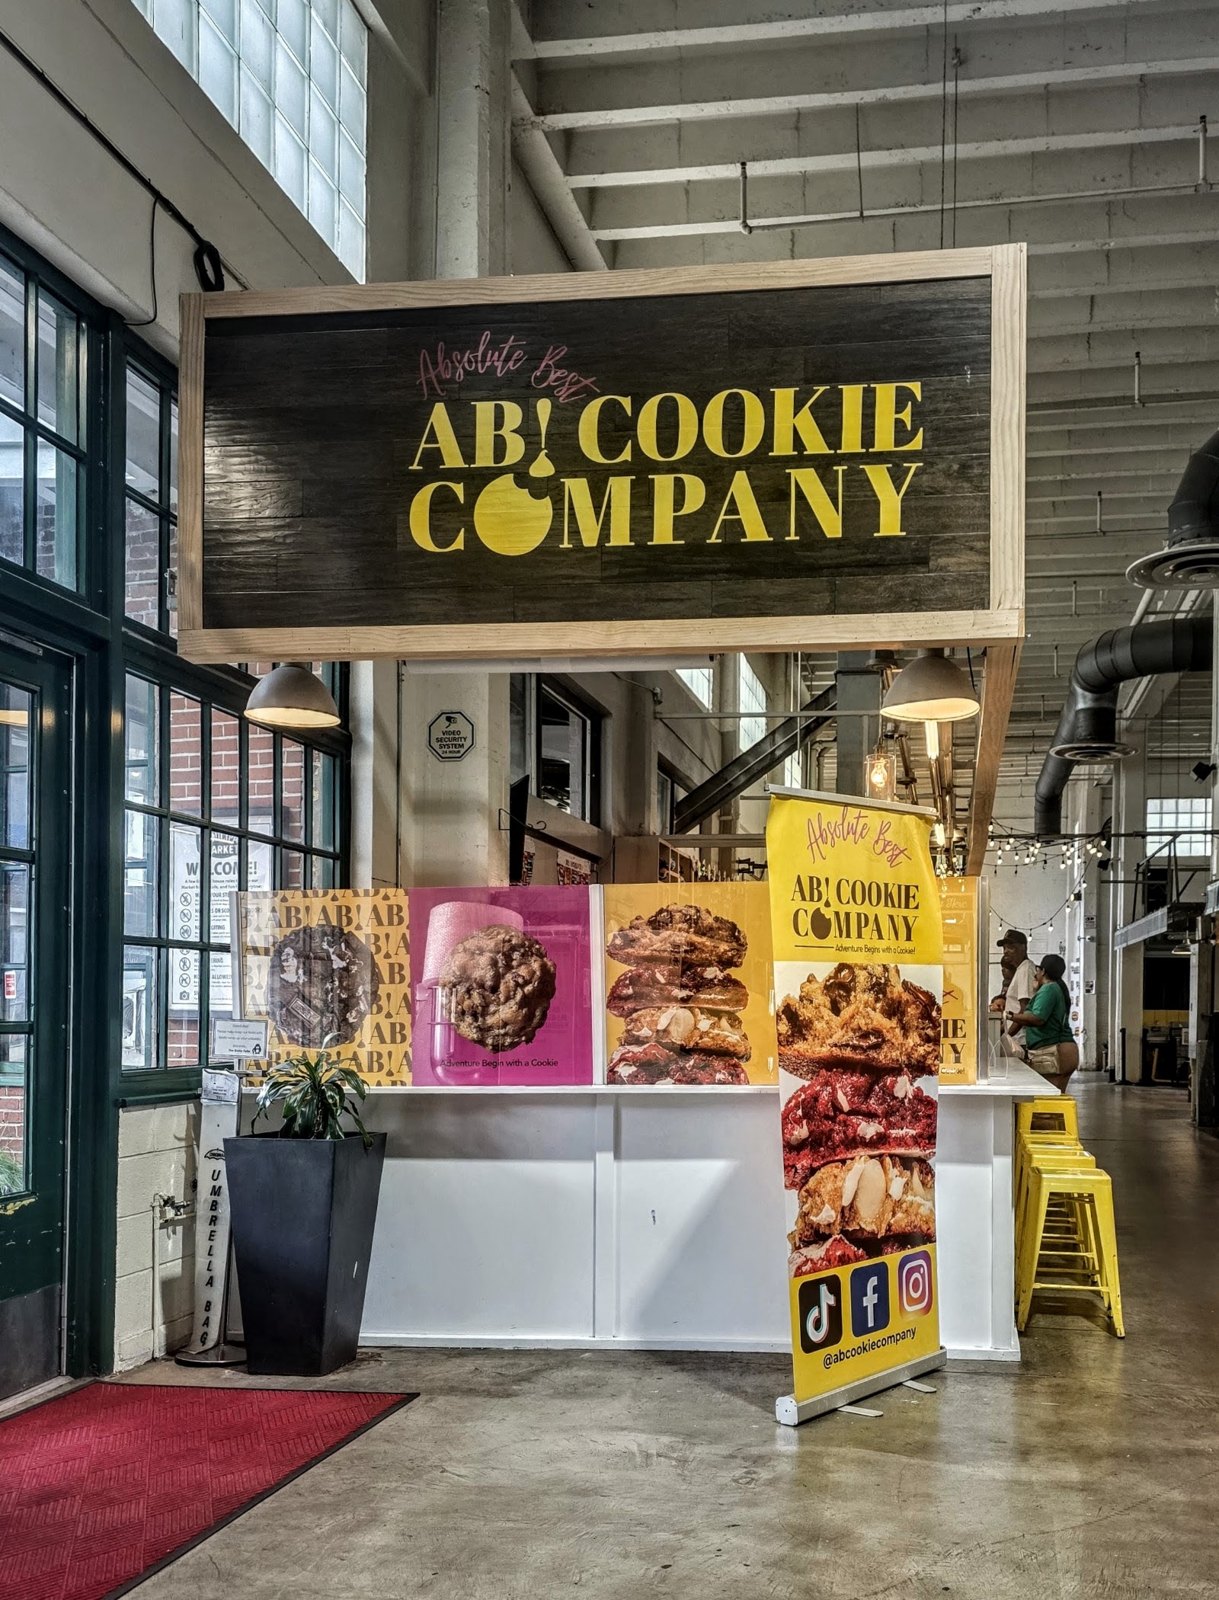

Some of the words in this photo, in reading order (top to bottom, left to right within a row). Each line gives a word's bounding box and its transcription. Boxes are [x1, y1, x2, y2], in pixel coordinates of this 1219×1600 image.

[416, 330, 528, 399] Absolute
[531, 345, 601, 403] Best
[409, 397, 556, 477] AB!
[578, 381, 924, 464] COOKIE
[408, 462, 924, 556] COMPANY
[211, 845, 238, 855] ARKET
[807, 805, 870, 864] Absolute
[872, 820, 912, 868] Best
[791, 874, 831, 908] AB!
[835, 878, 920, 910] COOKIE
[792, 907, 919, 942] COMPANY
[835, 943, 863, 952] Adventure
[864, 944, 880, 955] Begins
[882, 946, 893, 954] with
[897, 946, 916, 954] Cookie!
[440, 1059, 480, 1067] Adventure
[482, 1059, 503, 1068] Begin
[531, 1059, 559, 1067] Cookie
[205, 1169, 222, 1288] UMBRELLA
[199, 1300, 212, 1347] BAG
[823, 1326, 916, 1369] @abcookiecompany
